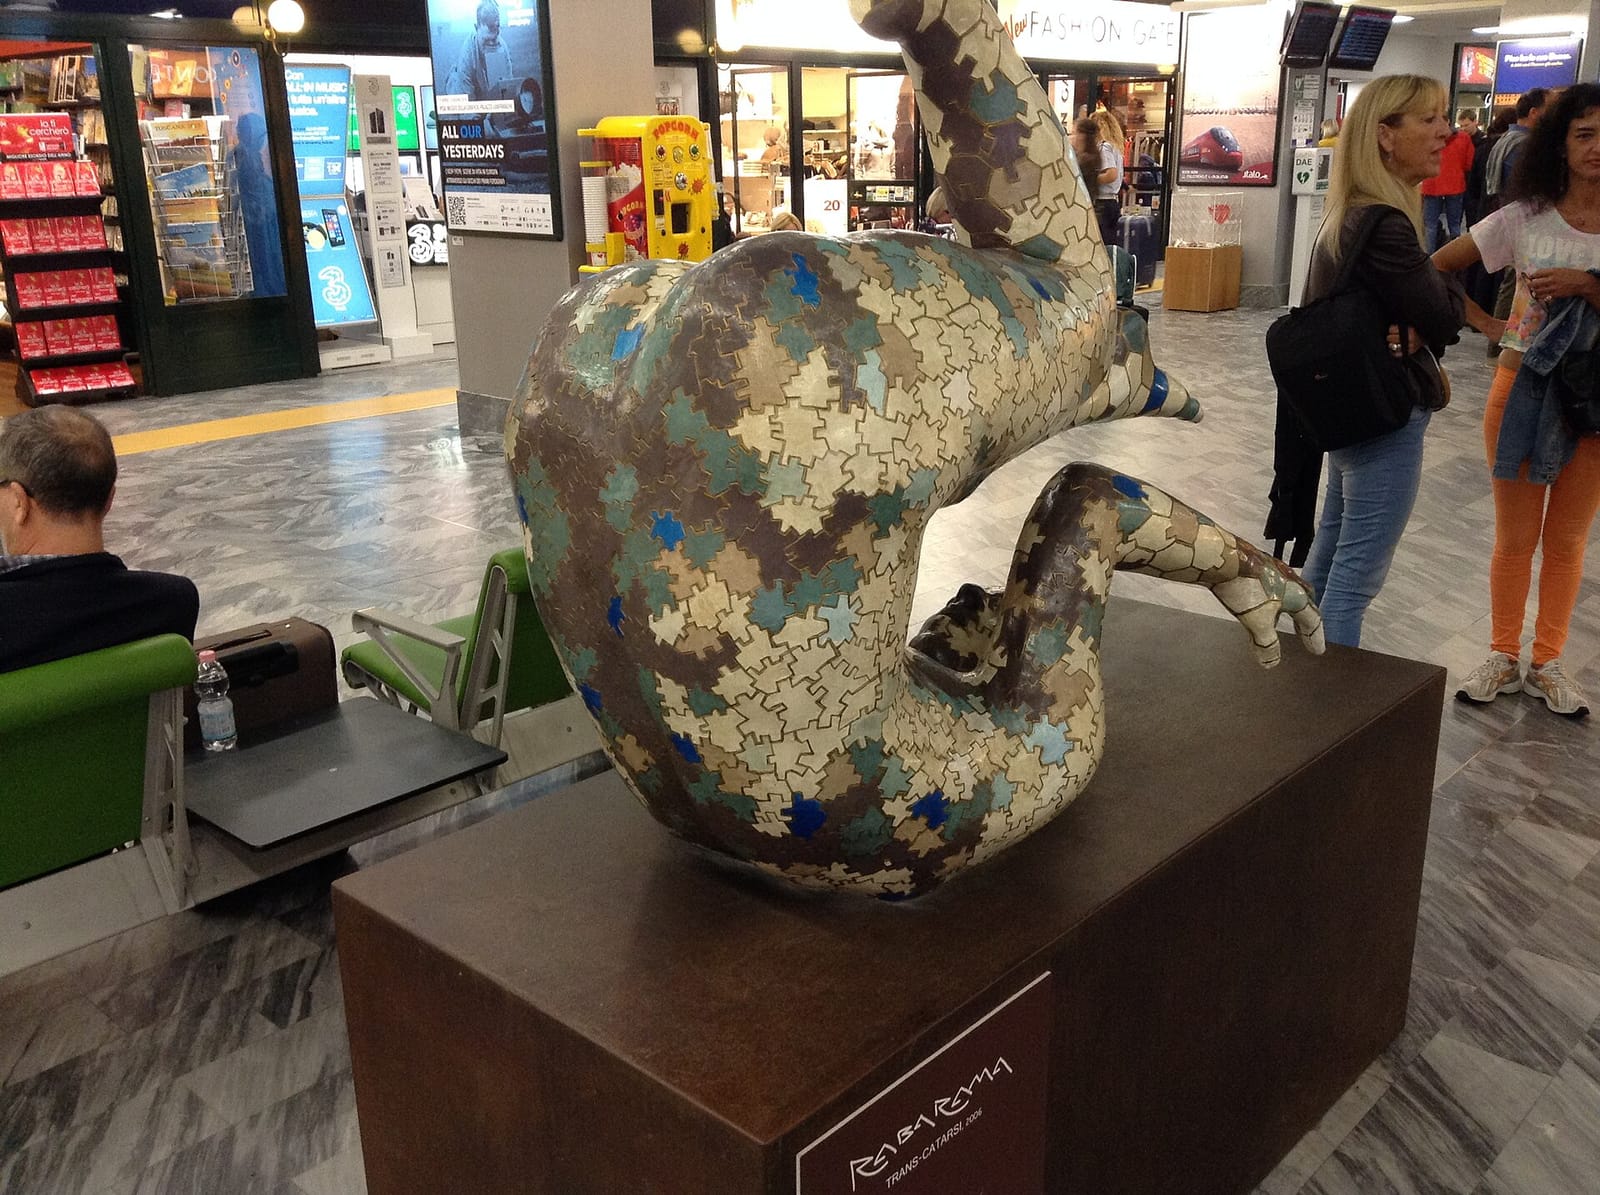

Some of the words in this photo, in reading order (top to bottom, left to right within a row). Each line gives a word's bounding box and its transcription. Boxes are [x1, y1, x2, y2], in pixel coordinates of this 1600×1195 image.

[1030, 10, 1121, 43] FASHON
[315, 82, 348, 93] MUSIC
[29, 126, 69, 136] cercherò
[442, 125, 459, 139] ALL
[460, 124, 482, 139] OUR
[652, 120, 700, 142] POPCORN
[443, 144, 505, 159] YESTERDAYS
[1296, 158, 1313, 166] DAE
[823, 199, 841, 211] 20
[965, 1107, 983, 1127] 2006
